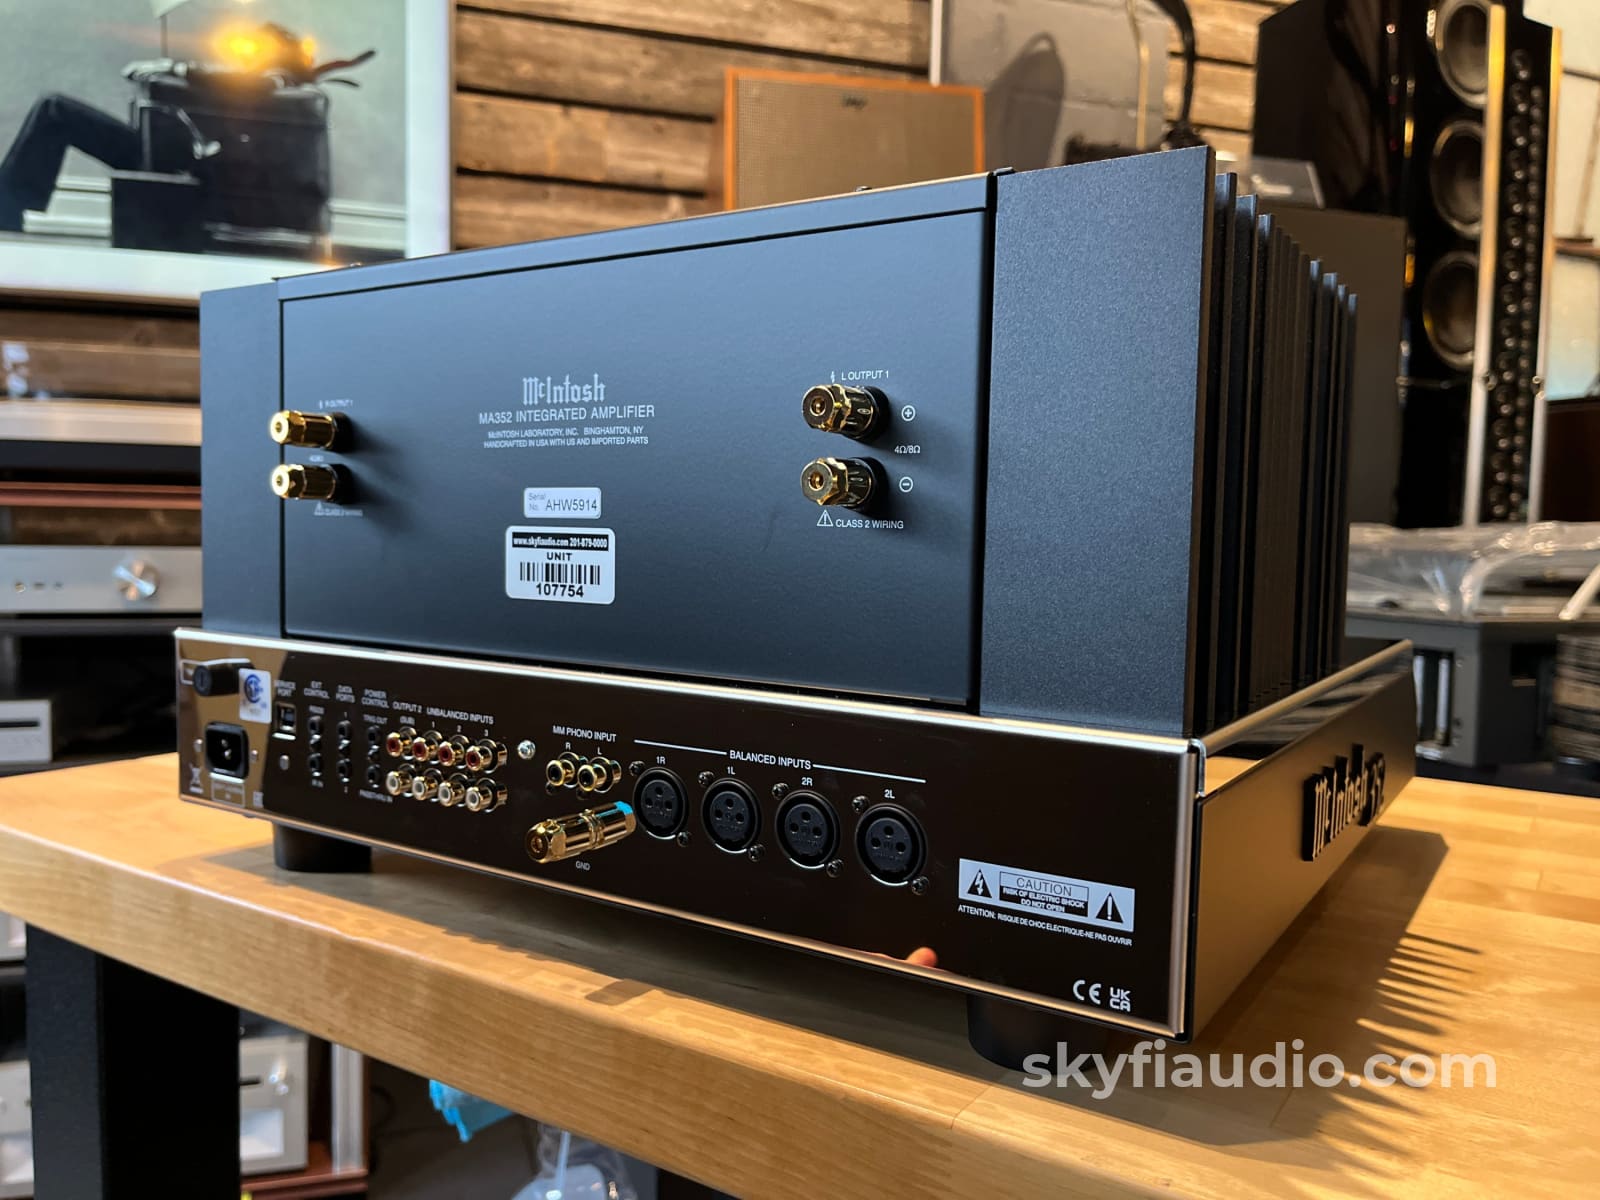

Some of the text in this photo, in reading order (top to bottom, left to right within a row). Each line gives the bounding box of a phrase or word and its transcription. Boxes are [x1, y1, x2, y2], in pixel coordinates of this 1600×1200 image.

[848, 370, 882, 380] OUTPUT
[522, 374, 606, 405] McIntosh
[479, 404, 655, 424] MA352 INTEGRATED AMPLIFIER
[520, 428, 564, 438] LABORATORY,
[565, 428, 579, 436] INC.
[633, 426, 644, 434] NY
[484, 436, 648, 448] HANDCRAFTED IN USA WITH US AND IMPORTED PARTS
[546, 499, 597, 511] AHW5914
[836, 519, 904, 529] CLASS 2 WIRING
[514, 536, 607, 548] www.skyfiaudio.com 201-879-0000
[546, 552, 572, 561] UNIT
[536, 584, 584, 598] 107754
[364, 689, 386, 698] POWER
[362, 697, 390, 708] CONTROL
[392, 701, 418, 712] OUTPUT
[426, 707, 494, 724] UNBALANCED INPUTS
[553, 726, 616, 742] MM PHONO INPUT
[566, 742, 571, 750] R
[598, 747, 602, 755] L
[656, 756, 666, 765] 1R
[730, 750, 811, 770] BALANCED INPUTS
[727, 766, 736, 775] 1L
[802, 777, 812, 786] 2R
[884, 789, 895, 799] 2L
[576, 860, 590, 871] GND
[1016, 877, 1072, 897] CAUTION
[1003, 888, 1084, 908] RISK OF ELECTRIC SHOCK
[1020, 898, 1065, 913] DO NOT OPEN
[958, 904, 996, 920] ATTENTION:
[998, 913, 1018, 924] RISQUE
[1020, 917, 1028, 926] DE
[1029, 918, 1046, 930] CHOC
[1095, 933, 1107, 942] PAS
[1108, 935, 1132, 946] OUVRIR
[1072, 980, 1102, 1005] CE
[1110, 986, 1131, 1001] UK
[1110, 998, 1131, 1012] CA
